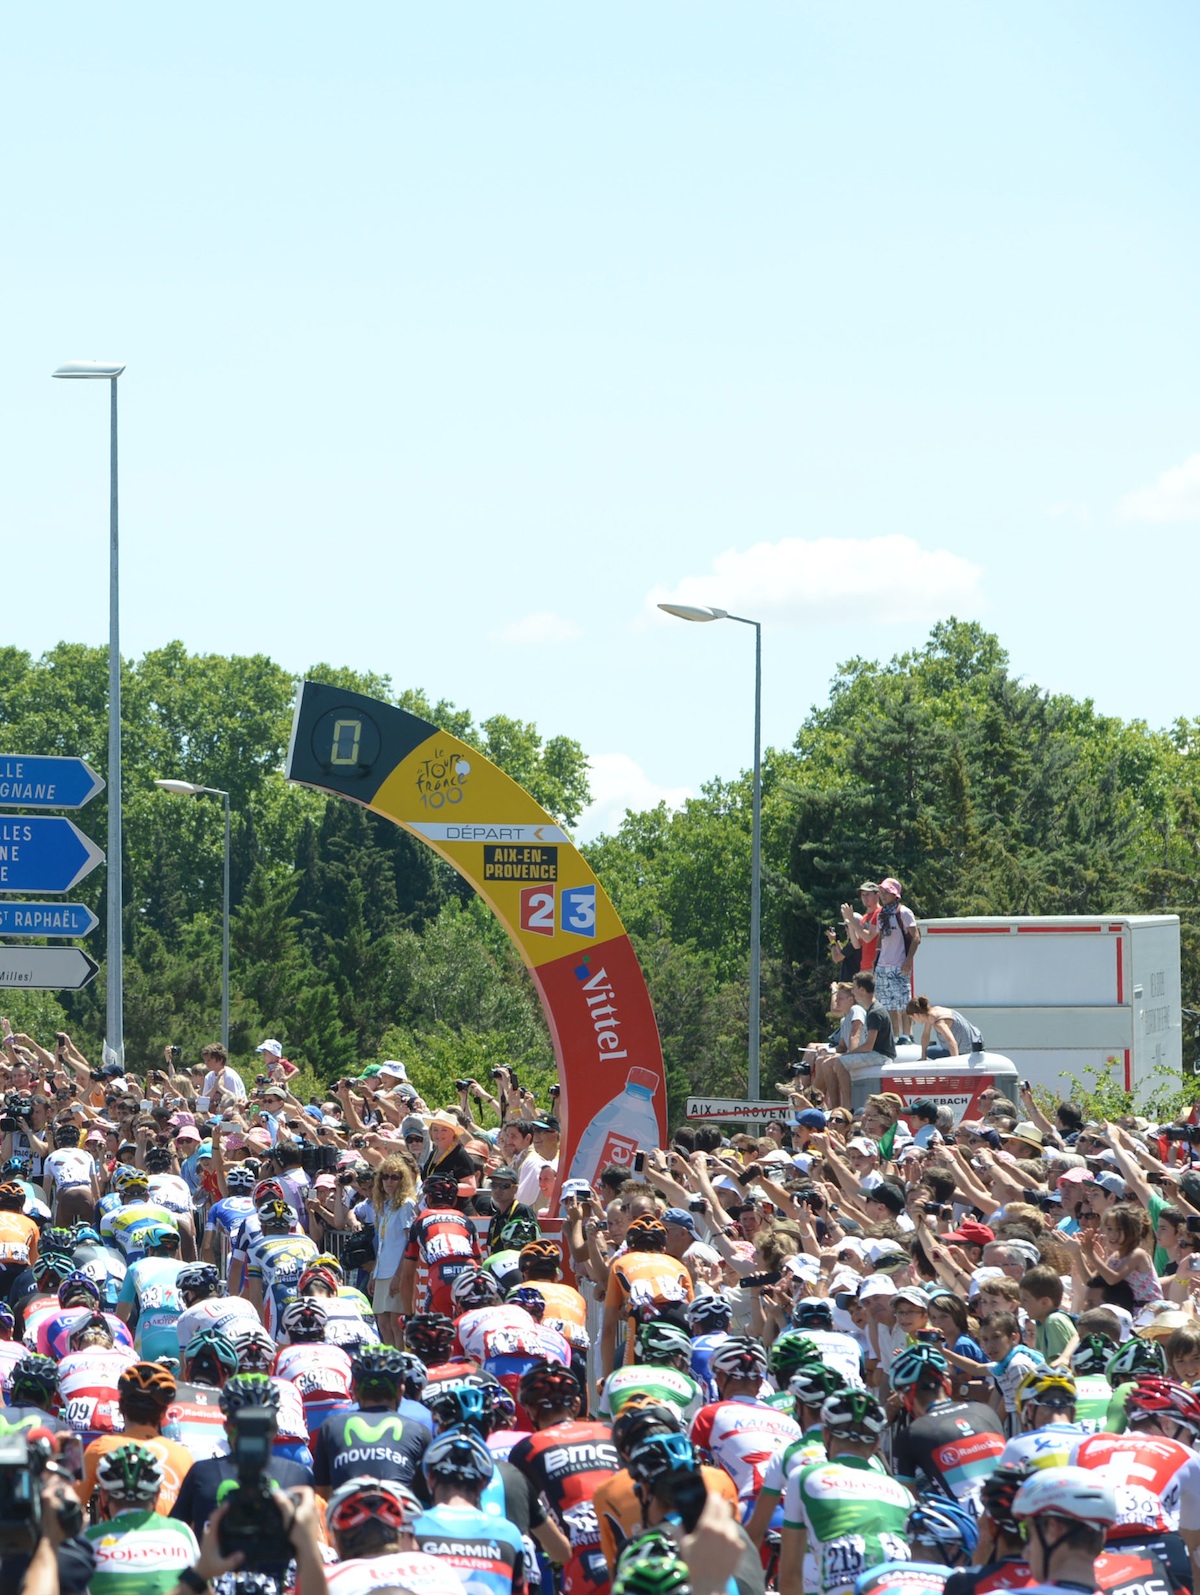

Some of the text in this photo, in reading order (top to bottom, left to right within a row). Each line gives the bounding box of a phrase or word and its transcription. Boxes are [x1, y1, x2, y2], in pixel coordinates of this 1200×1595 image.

[420, 786, 463, 809] 100
[446, 824, 524, 840] DÉPART
[494, 848, 548, 862] AIX-EN-
[486, 864, 556, 879] PROVENCE
[14, 909, 78, 928] RAPHAËL
[528, 894, 554, 928] 2
[570, 894, 595, 928] 3
[582, 966, 628, 1062] Vittel
[691, 1104, 711, 1115] AIX
[334, 1447, 408, 1468] movistar
[544, 1444, 618, 1474] BMC
[96, 1546, 188, 1563] Sojasun
[422, 1542, 501, 1559] GARMIN
